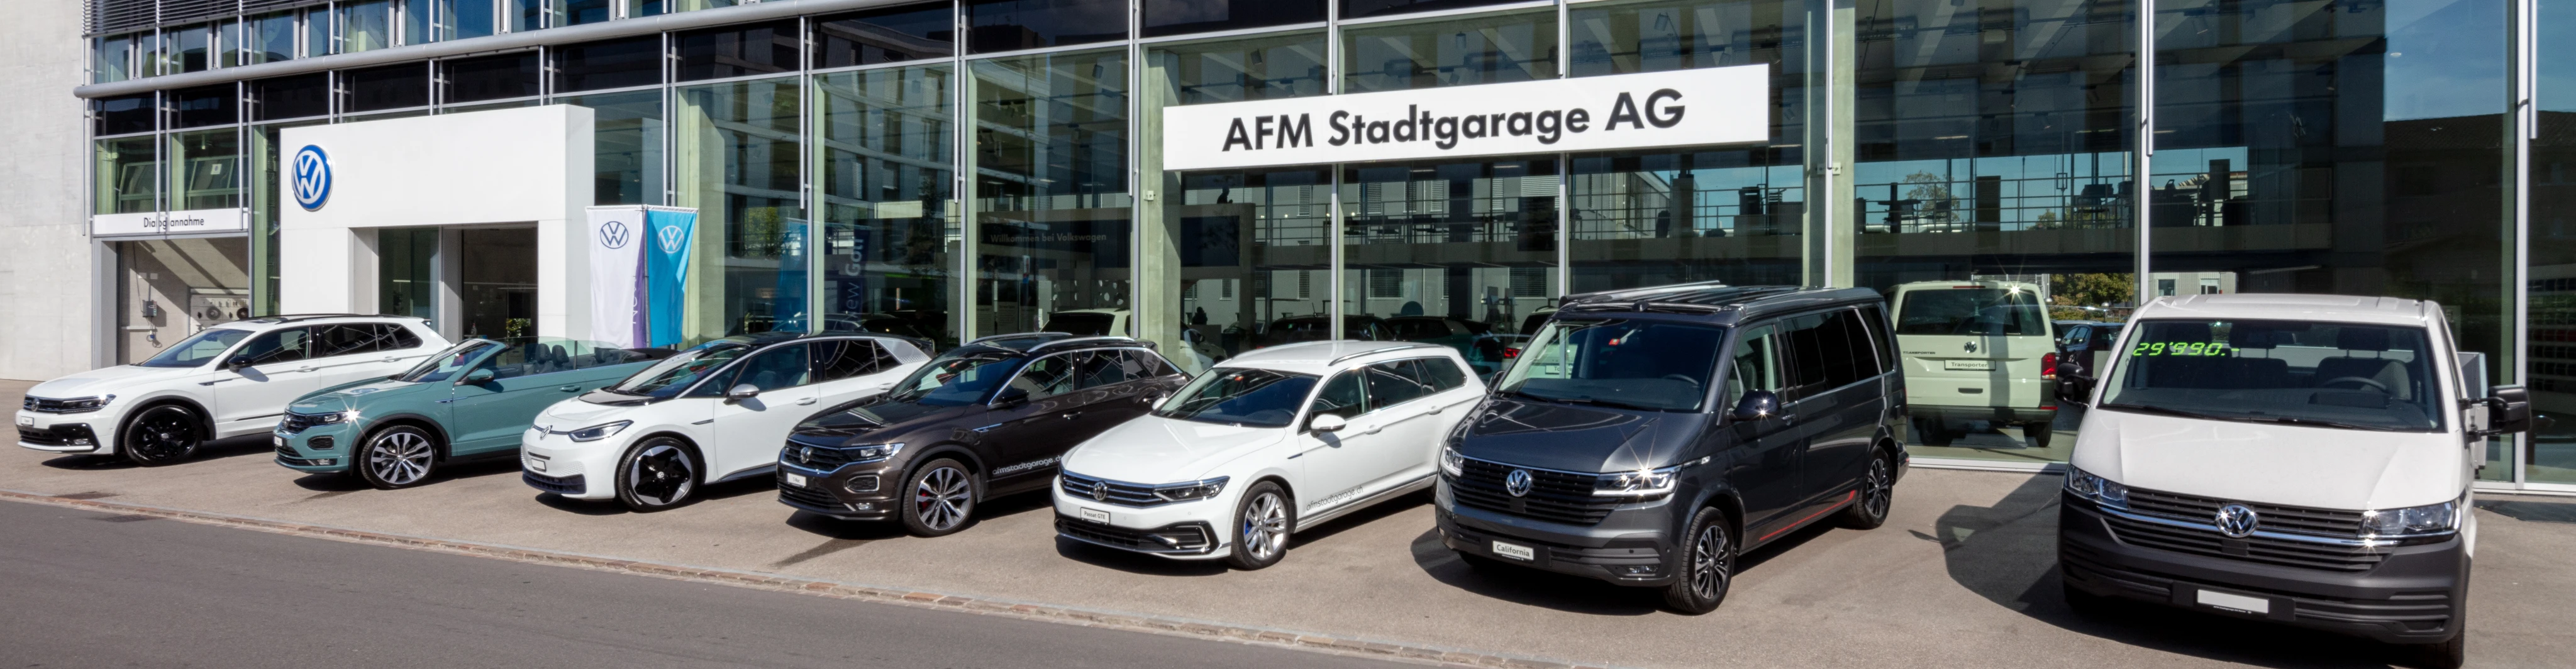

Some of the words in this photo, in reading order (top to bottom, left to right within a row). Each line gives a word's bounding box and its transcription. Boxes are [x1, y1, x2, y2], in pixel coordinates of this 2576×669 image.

[1221, 113, 1313, 152] AFM
[1328, 104, 1589, 150] Stadtgarage
[1605, 88, 1685, 131] AG
[991, 233, 1040, 243] Willkommen
[1041, 231, 1055, 242] bei
[1057, 231, 1107, 243] Volkswagen
[992, 455, 1062, 475] afmstadtgarage.ch
[1306, 485, 1363, 511] afmstadtgarage.ch
[1496, 544, 1530, 557] California
